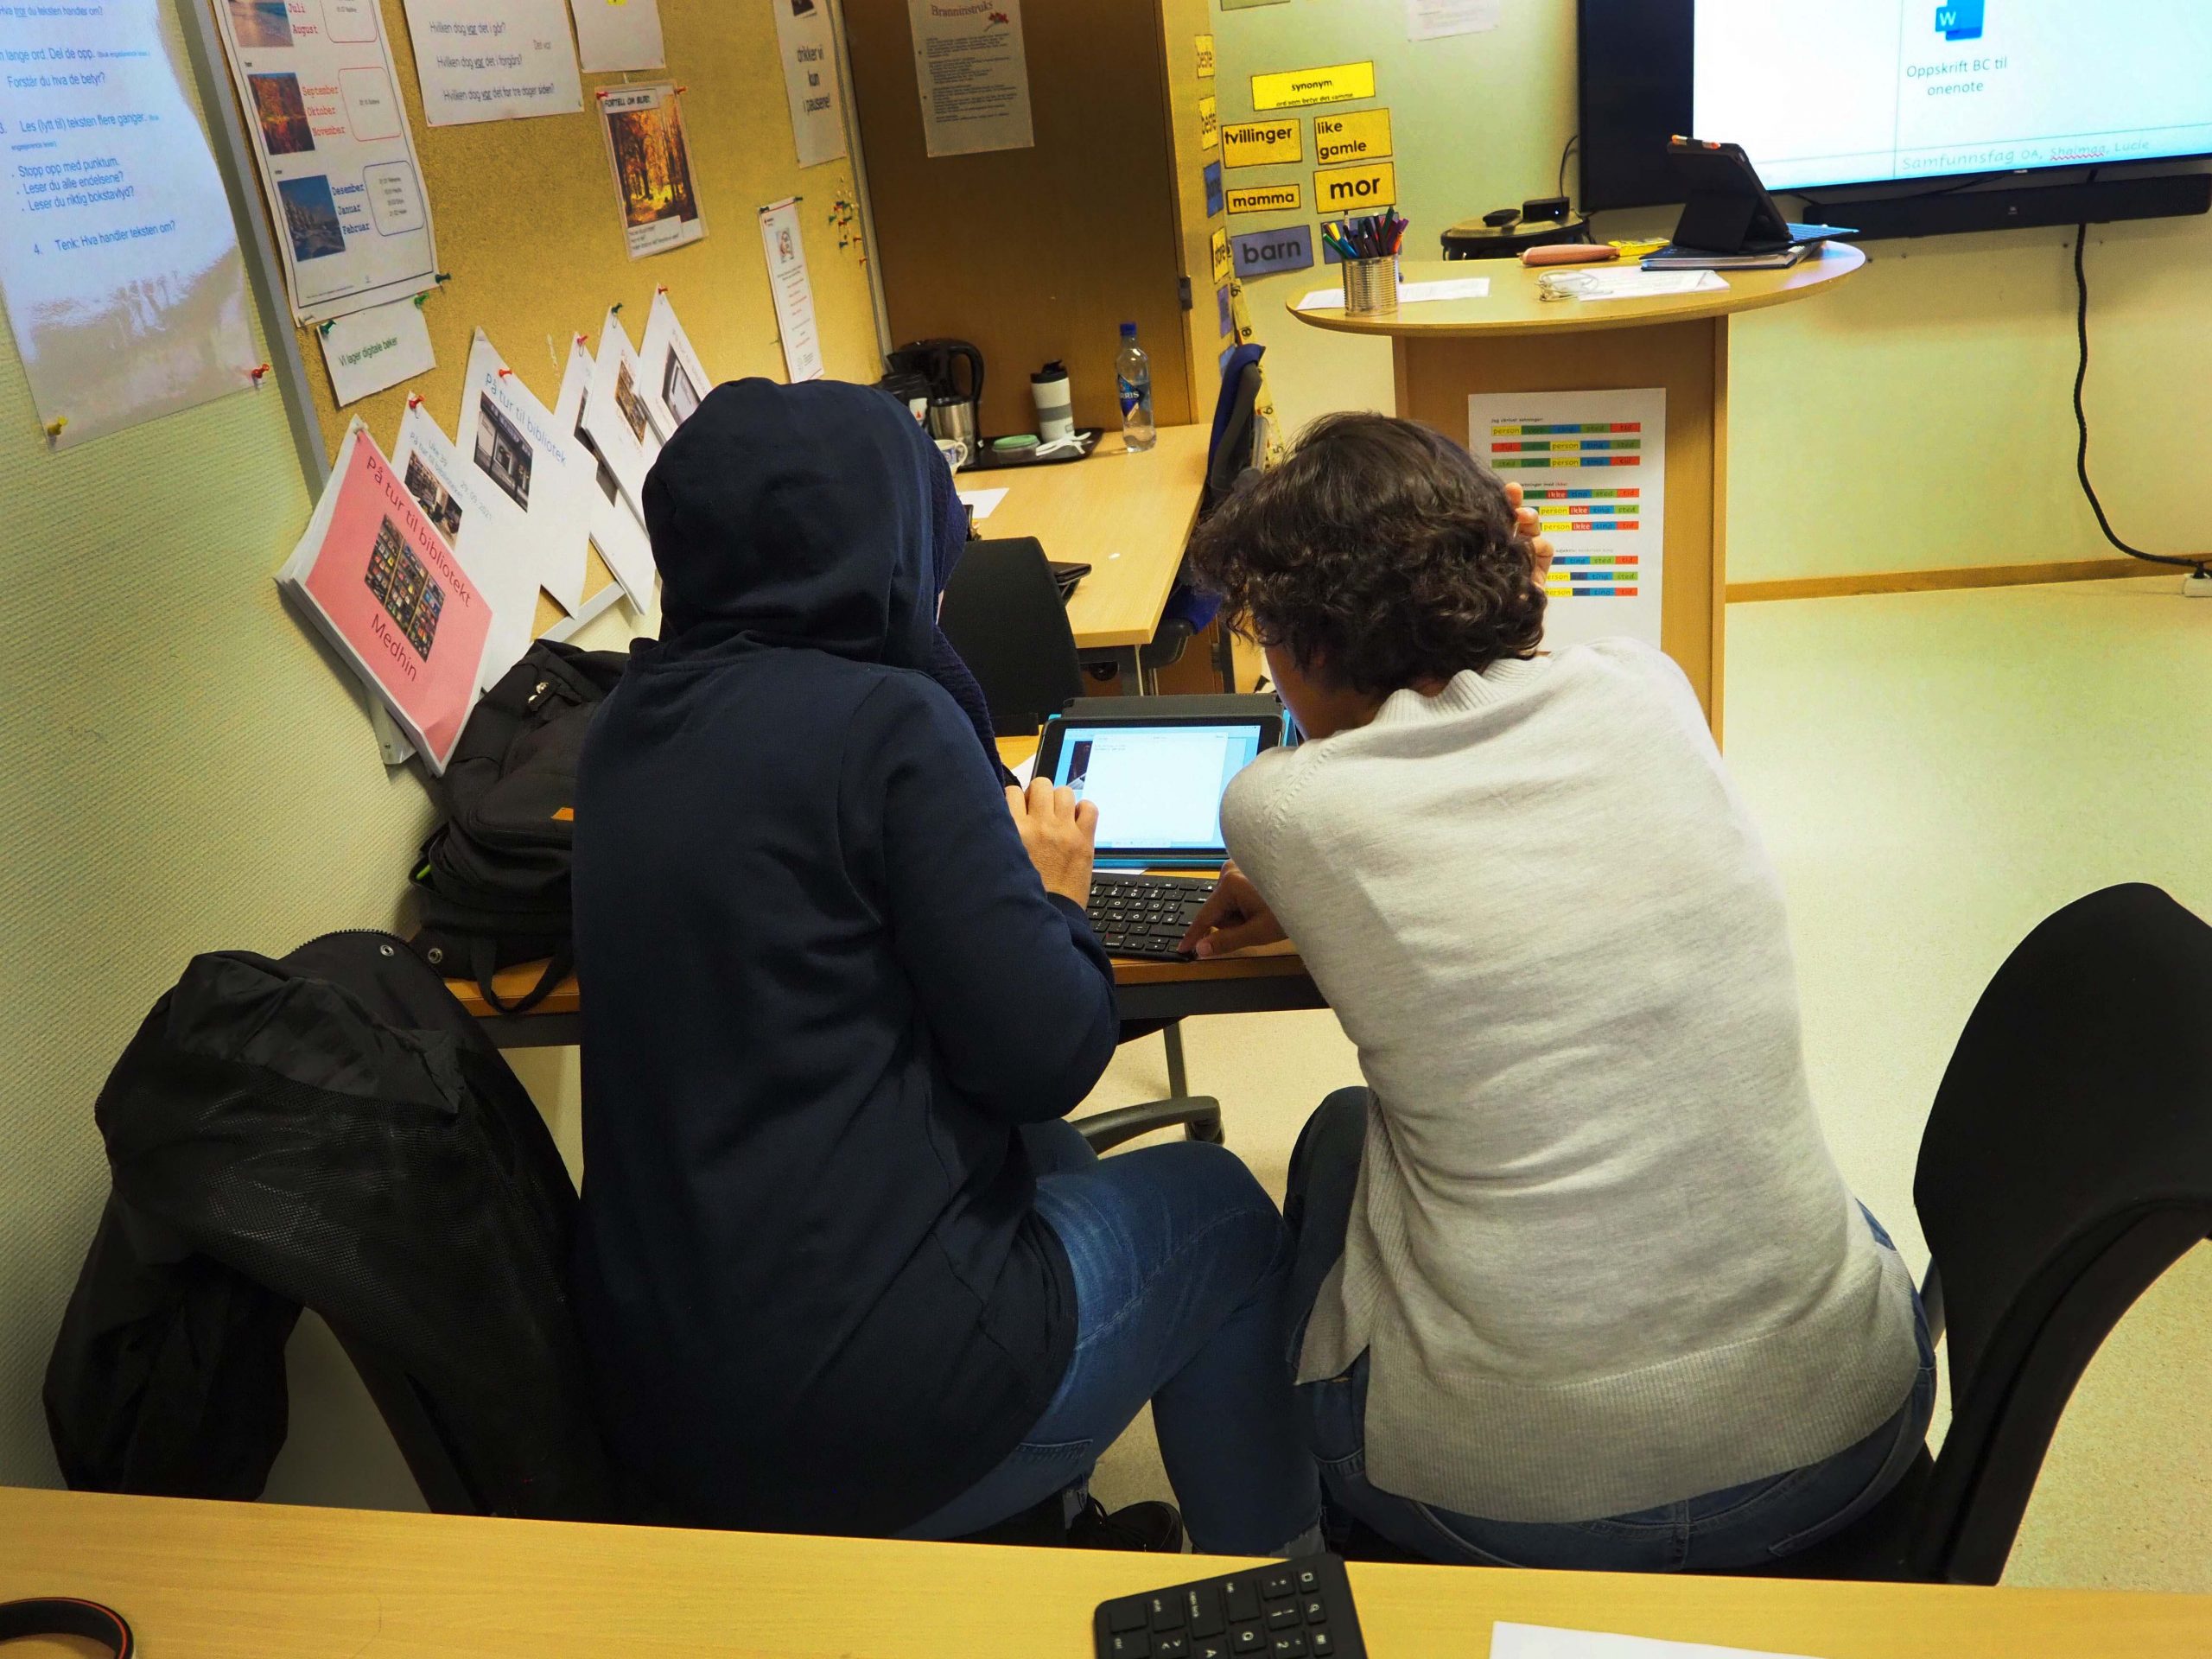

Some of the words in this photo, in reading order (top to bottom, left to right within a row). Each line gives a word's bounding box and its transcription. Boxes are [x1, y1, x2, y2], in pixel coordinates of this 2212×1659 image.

[289, 3, 305, 13] Juli
[1939, 11, 1957, 26] W
[292, 24, 318, 36] August
[48, 48, 63, 60] Del
[66, 48, 75, 60] de
[1906, 60, 1968, 79] Oppskrift
[1973, 59, 1992, 72] BC
[1995, 56, 2008, 70] til
[40, 75, 51, 86] du
[53, 74, 67, 86] hva
[69, 73, 79, 85] de
[80, 72, 105, 87] betyr?
[1291, 79, 1332, 92] synonym
[302, 85, 340, 99] September
[1927, 81, 1985, 97] onenote
[1302, 96, 1319, 106] betyr
[307, 106, 336, 117] Oktober
[20, 120, 36, 132] Les
[67, 116, 98, 130] teksten
[1318, 121, 1343, 135] like
[312, 126, 346, 137] November
[1224, 127, 1293, 145] tvillinger
[1319, 139, 1367, 159] gamle
[1903, 149, 2015, 171] Samfunnsfag
[2114, 140, 2150, 153] Lucie
[18, 165, 43, 178] Stopp
[45, 164, 61, 176] opp
[63, 161, 81, 172] med
[23, 182, 47, 194] Leser
[49, 180, 60, 192] du
[62, 177, 77, 189] alle
[79, 171, 124, 188] endelsene?
[332, 182, 365, 196] Desember
[1330, 177, 1381, 200] mor
[28, 199, 52, 212] Leser
[54, 196, 66, 207] du
[1233, 194, 1295, 207] mamma
[338, 204, 362, 215] Januar
[342, 223, 371, 235] Februar
[34, 244, 42, 255] 4.
[54, 238, 80, 252] Tenk:
[81, 235, 99, 247] Hva
[99, 229, 129, 245] handler
[130, 225, 158, 239] teksten
[159, 220, 176, 233] om?
[1243, 240, 1301, 264] barn
[362, 342, 383, 359] digitale
[499, 390, 513, 410] tur
[516, 407, 525, 424] til
[526, 416, 566, 464] bibliotek
[1492, 427, 1520, 435] person
[1552, 442, 1579, 451] person
[1552, 458, 1579, 467] person
[1541, 506, 1567, 515] person
[366, 455, 385, 486] På
[385, 483, 405, 512] tur
[406, 512, 418, 533] til
[418, 526, 472, 607] bibliotekt
[1543, 523, 1571, 531] person
[1617, 572, 1635, 581] sted
[372, 613, 416, 682] Medhin
